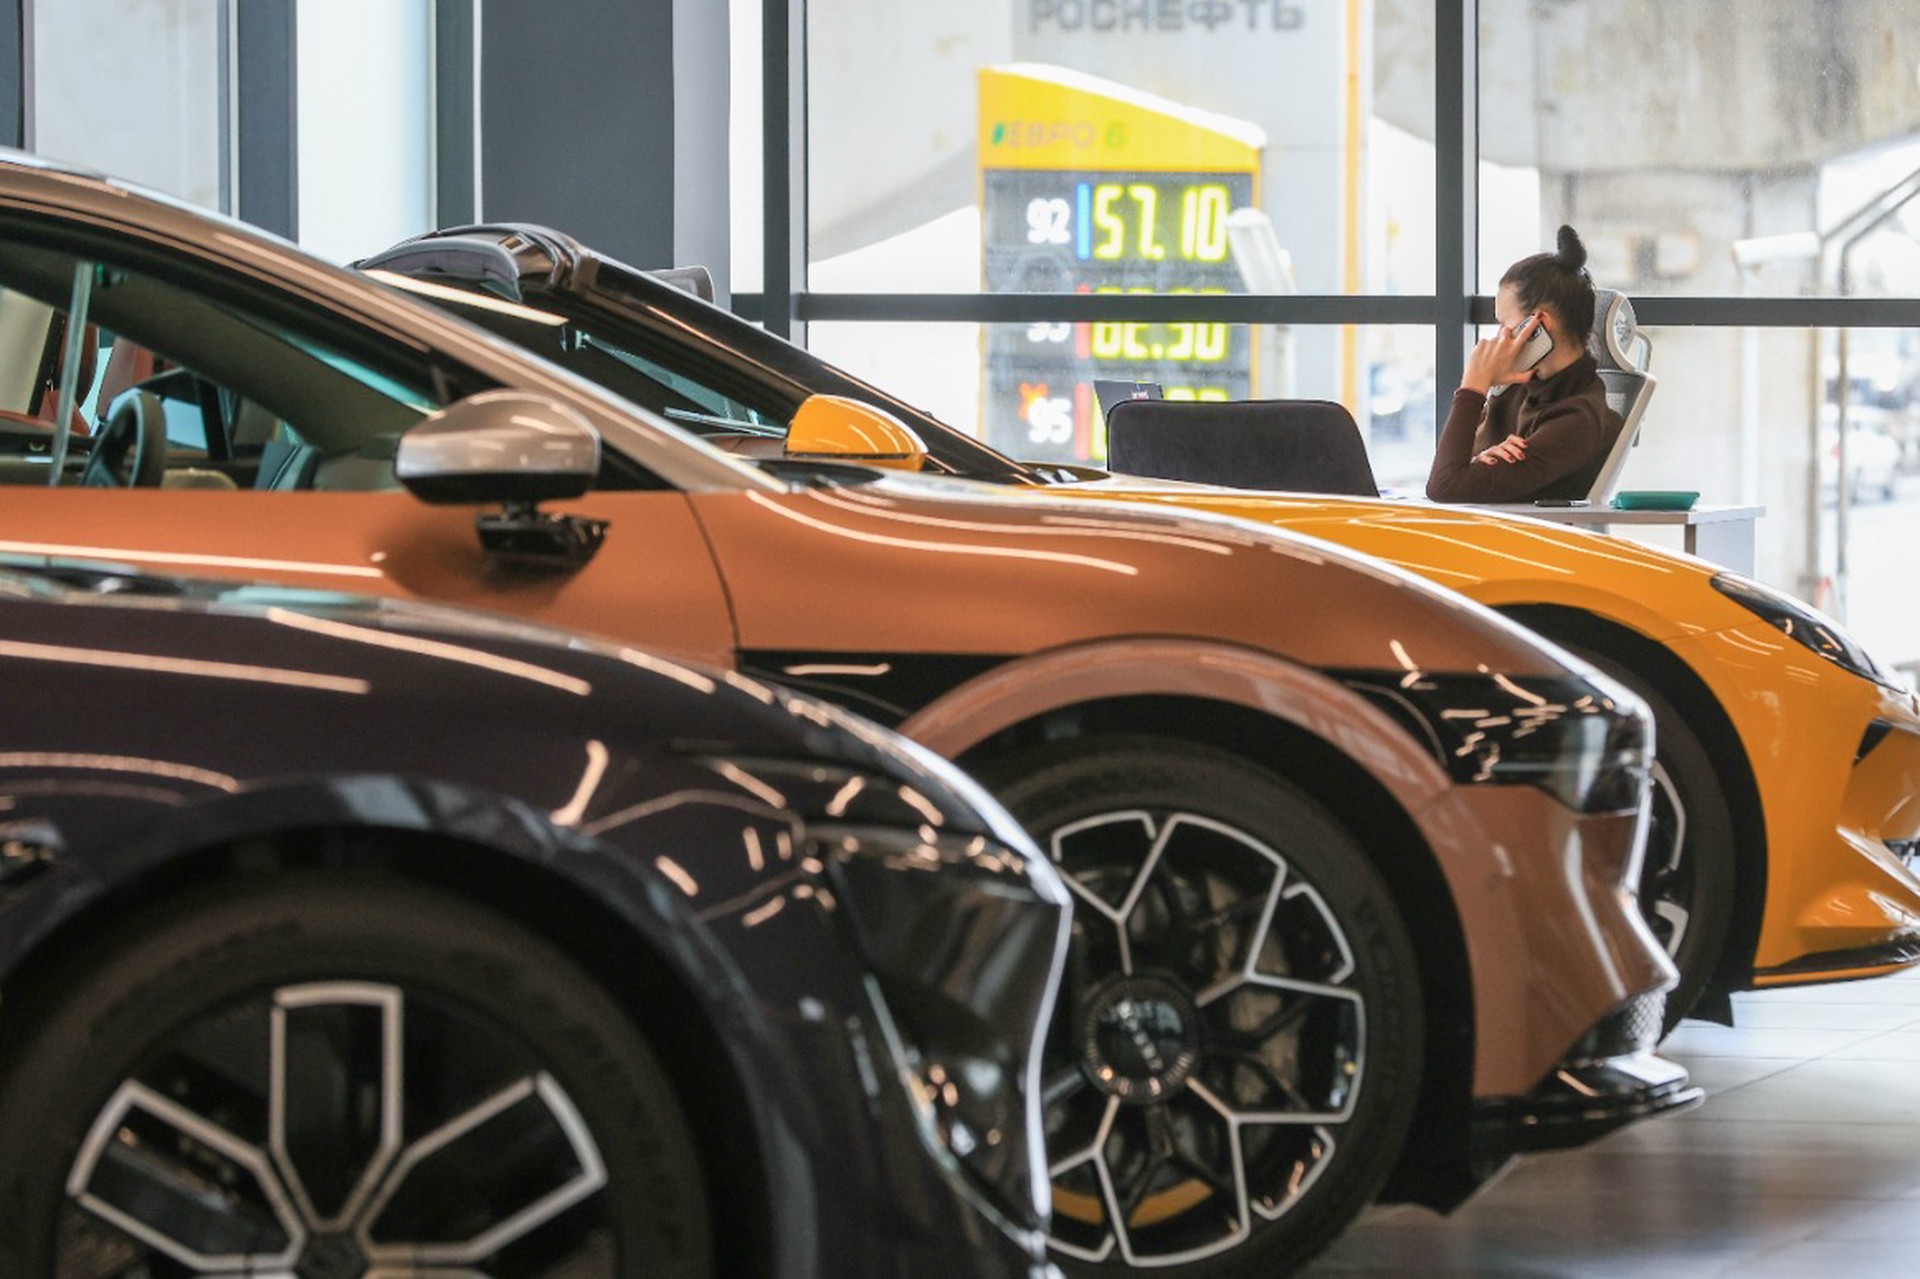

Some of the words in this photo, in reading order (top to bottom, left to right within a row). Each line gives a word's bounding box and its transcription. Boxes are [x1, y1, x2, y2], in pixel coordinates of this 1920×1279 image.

[1029, 0, 1306, 31] РОСНЕФТЬ
[1027, 197, 1071, 243] 92
[1094, 183, 1229, 260] 57.10
[1027, 397, 1073, 444] 95
